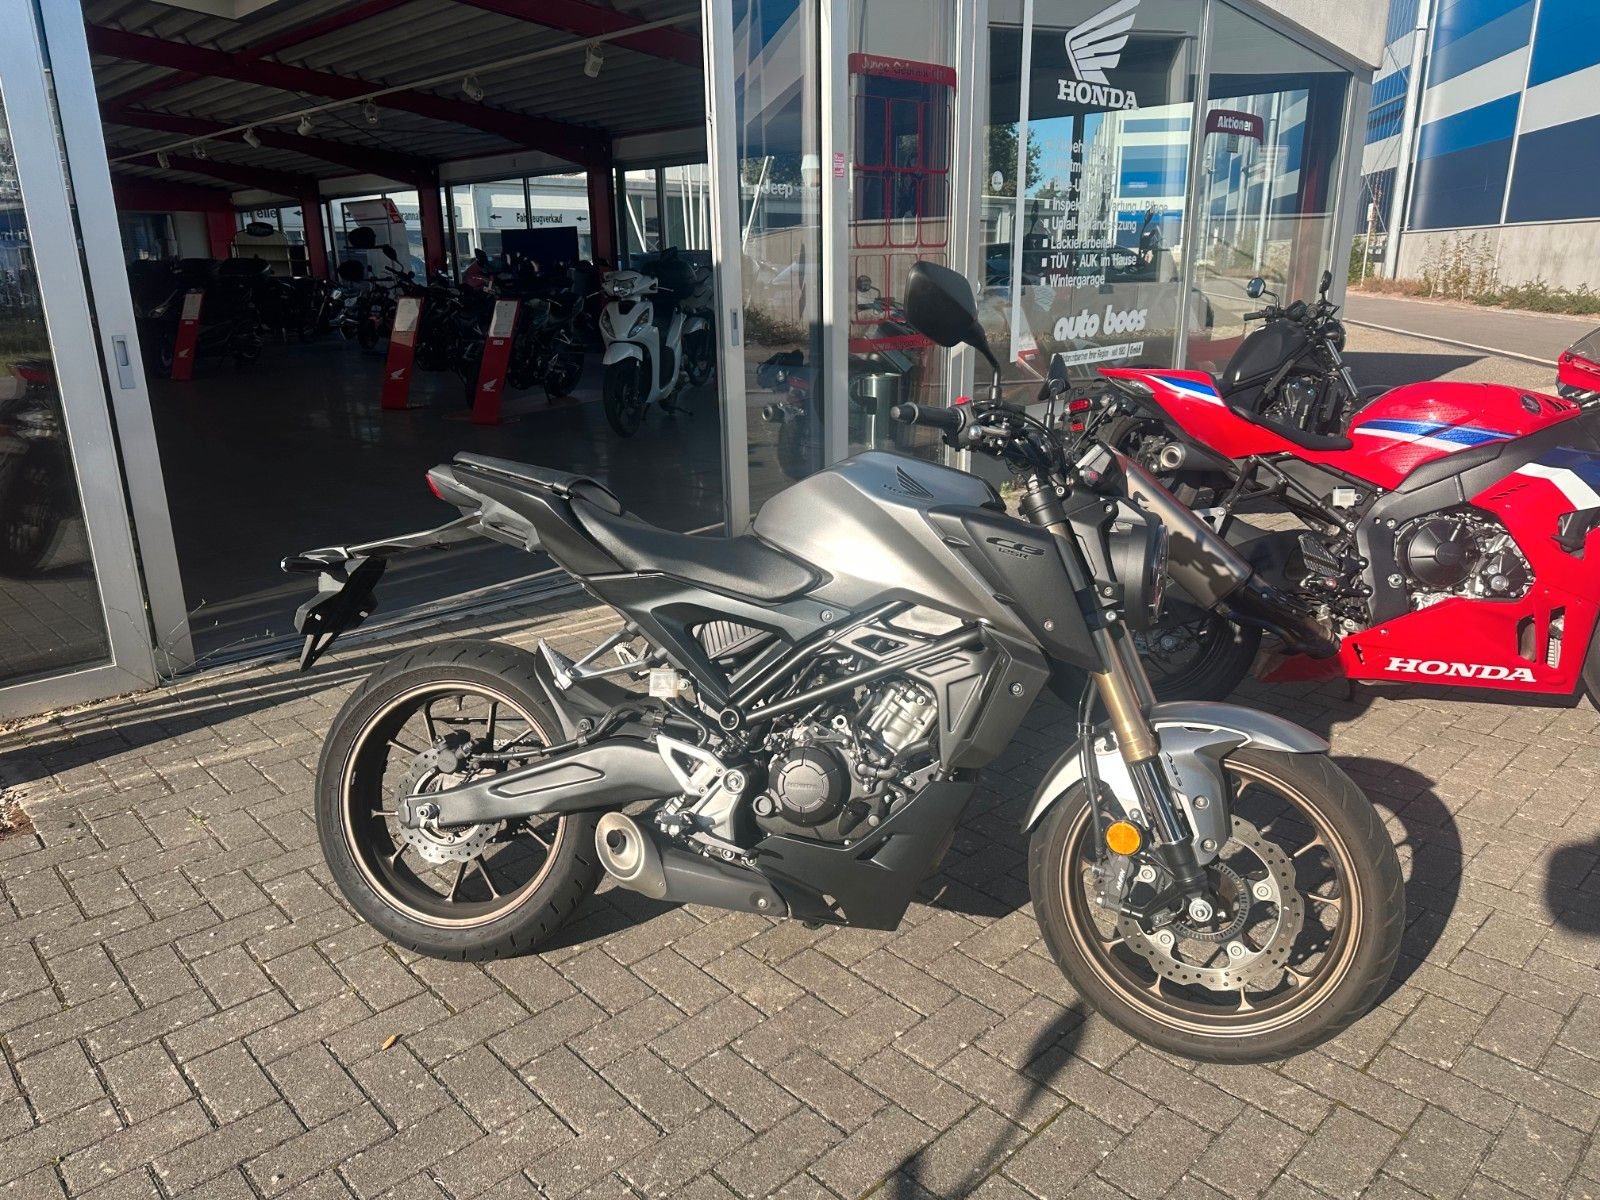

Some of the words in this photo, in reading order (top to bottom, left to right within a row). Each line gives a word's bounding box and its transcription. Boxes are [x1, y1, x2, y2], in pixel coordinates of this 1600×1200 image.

[1057, 79, 1138, 110] HONDA
[1217, 115, 1253, 132] Aktionen
[762, 178, 793, 199] Jeep
[516, 212, 563, 225] Faheugverkauf
[1050, 235, 1115, 250] Lackierarbeiten
[1050, 252, 1069, 269] TÜV
[1080, 253, 1099, 267] AUK
[1101, 254, 1111, 266] im
[1112, 252, 1137, 265] Hause
[1049, 274, 1106, 289] Wintergarage
[1053, 309, 1100, 341] auto
[1102, 304, 1148, 336] boos
[1384, 656, 1537, 683] HONDA
